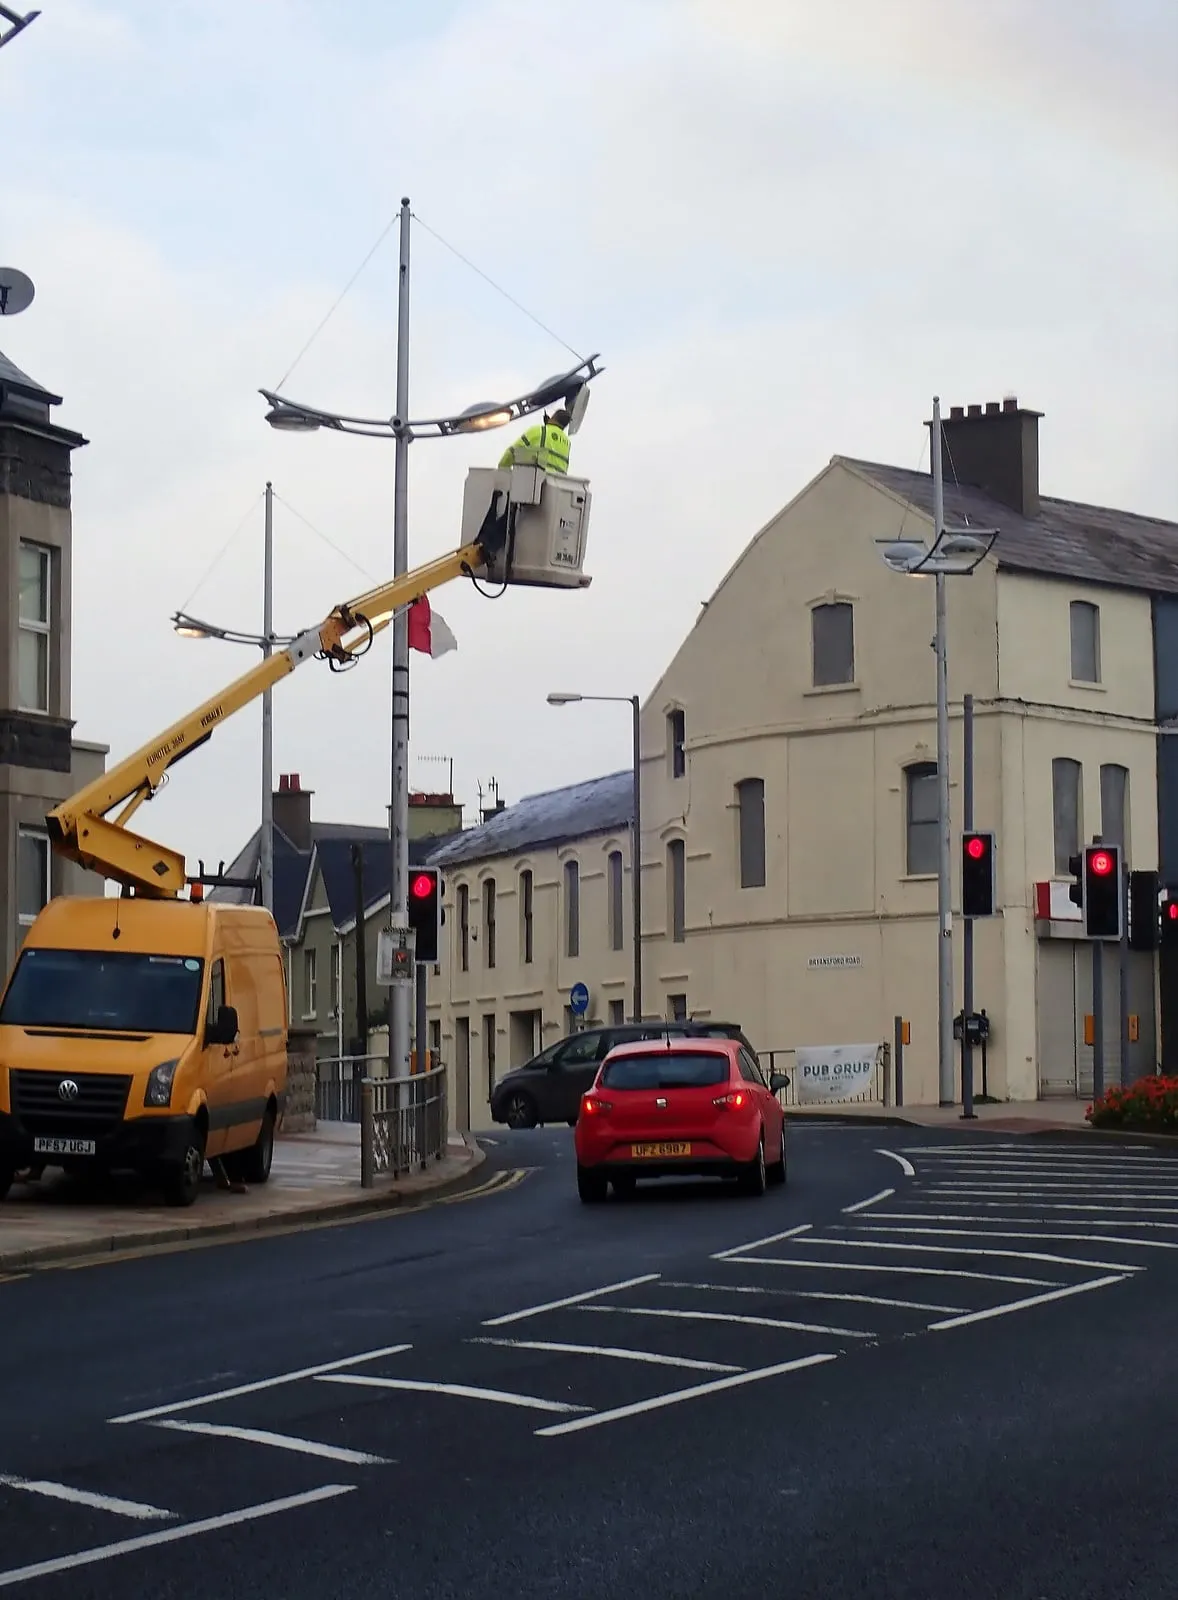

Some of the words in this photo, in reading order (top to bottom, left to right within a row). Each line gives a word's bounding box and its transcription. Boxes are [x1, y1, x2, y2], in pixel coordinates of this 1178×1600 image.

[845, 956, 861, 964] ROAD
[803, 1065, 830, 1077] PUB
[833, 1062, 871, 1074] GRUB
